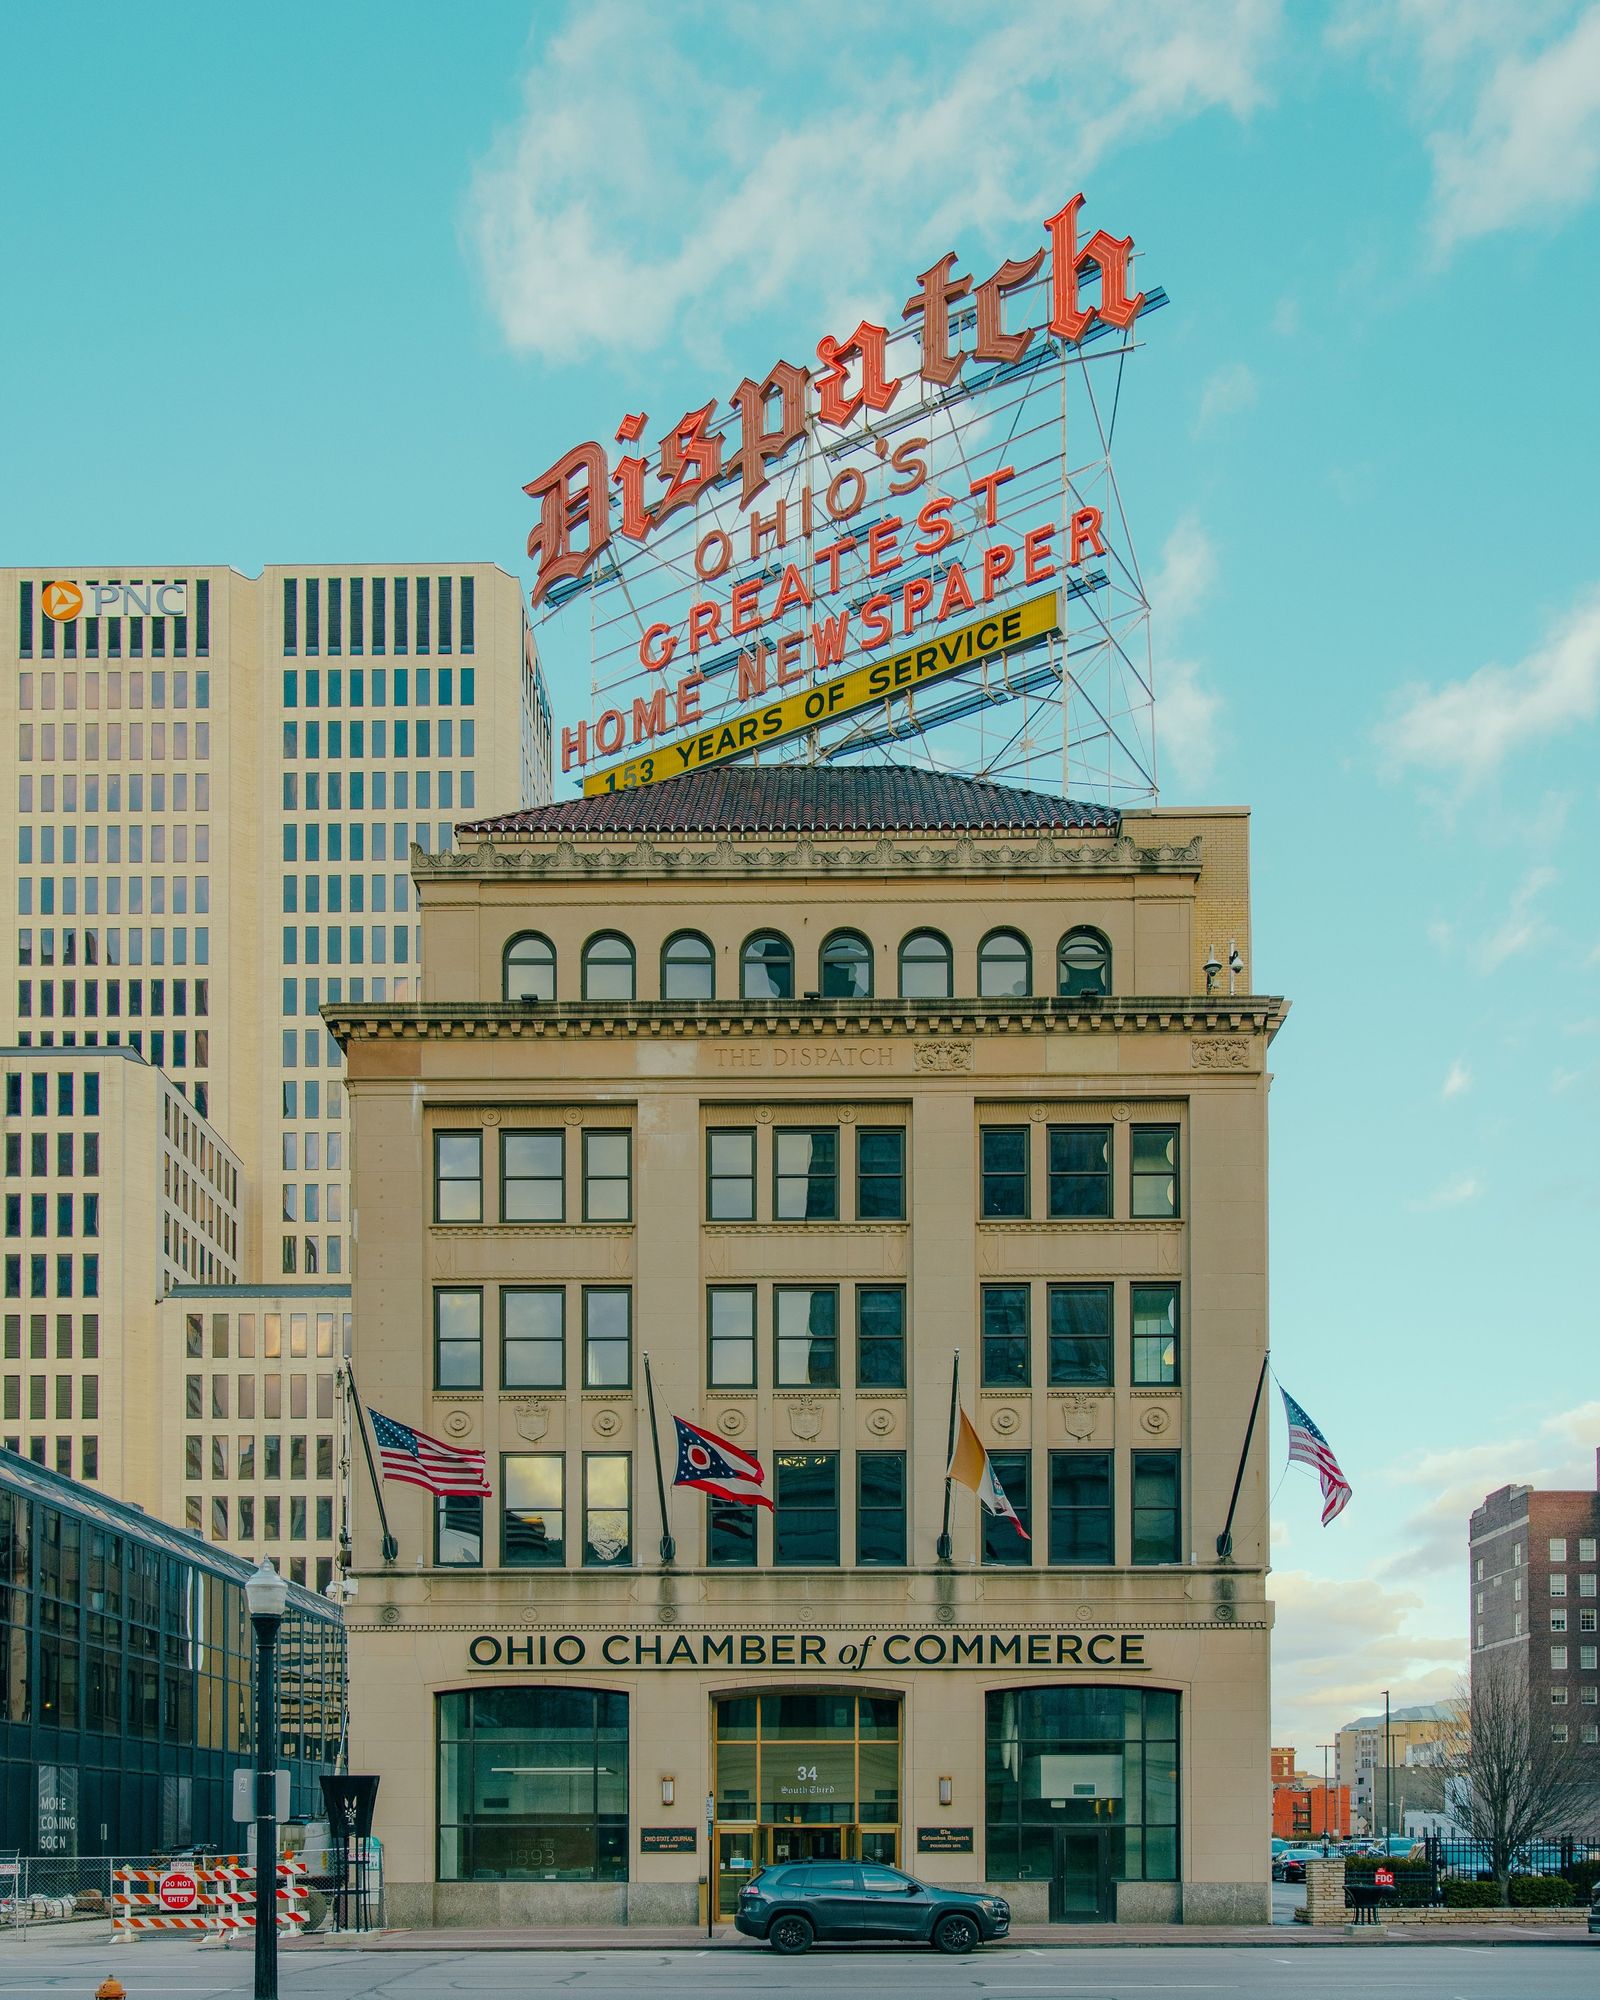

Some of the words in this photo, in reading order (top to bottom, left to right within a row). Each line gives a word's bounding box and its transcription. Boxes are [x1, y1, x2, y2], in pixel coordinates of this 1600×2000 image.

[522, 192, 1146, 609] Dispatch
[694, 437, 927, 580] OHIO'S
[639, 466, 1015, 671] GREATEST
[90, 584, 184, 616] PNC
[562, 672, 704, 772] HOME
[738, 506, 1105, 703] NEWSPAPER
[605, 758, 654, 792] 153
[676, 707, 783, 768] YEARS
[804, 683, 845, 719] OF
[869, 612, 1022, 695] SERVICE
[714, 1048, 763, 1067] THE
[773, 1048, 894, 1067] DISPATCH
[469, 1635, 586, 1666] OHIO
[602, 1634, 826, 1665] CHAMBER
[838, 1635, 876, 1670] of
[883, 1634, 1145, 1665] COMMERCE
[797, 1766, 818, 1781] 34
[780, 1786, 808, 1794] South
[809, 1785, 835, 1794] Third
[41, 1797, 66, 1810] MORE
[41, 1816, 76, 1830] COMING
[40, 1835, 66, 1849] SOON
[510, 1849, 555, 1866] 1893
[1375, 1874, 1393, 1883] FDC
